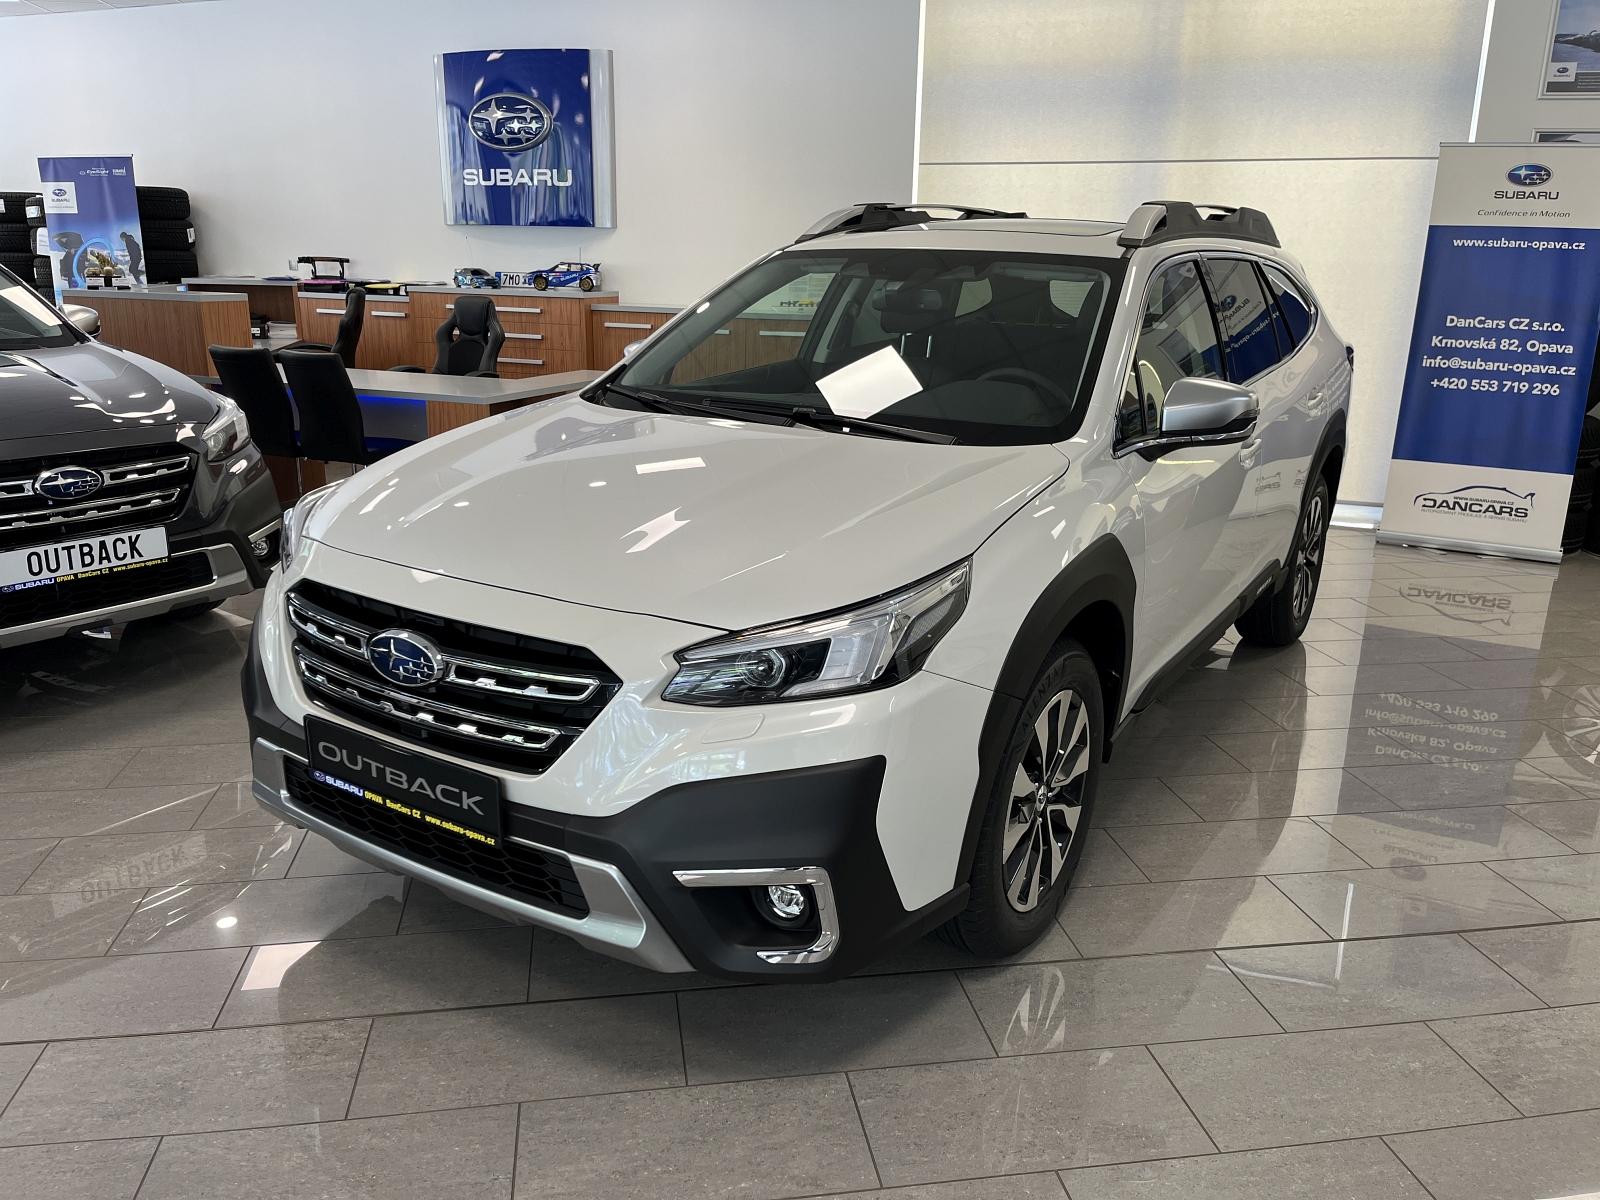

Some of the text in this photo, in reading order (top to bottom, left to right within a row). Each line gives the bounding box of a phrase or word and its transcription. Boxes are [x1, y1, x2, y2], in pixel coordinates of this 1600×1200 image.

[463, 168, 573, 187] SUBARU
[1493, 190, 1560, 201] SUBARU
[1477, 209, 1571, 219] Confidence in Motion
[1453, 237, 1586, 251] www.subaru-opava.cz
[1446, 315, 1566, 332] DanCars CZ s.r.o.
[1431, 335, 1574, 355] Krnovská 82, Opava
[1422, 355, 1577, 377] info@subaru-opava.cz
[1430, 378, 1561, 396] +420 553 719 296
[1422, 497, 1529, 518] DANCARS
[26, 533, 144, 577] OUTBACK
[14, 577, 55, 591] SUBARU
[56, 574, 75, 583] OPAVA
[77, 569, 101, 579] DanCars
[112, 557, 169, 573] www.subaru-opava.cz
[317, 741, 485, 816] OUTBACK
[325, 775, 496, 846] SUBARU OPAVA DanCars CZ www.subaru-opava.cz
